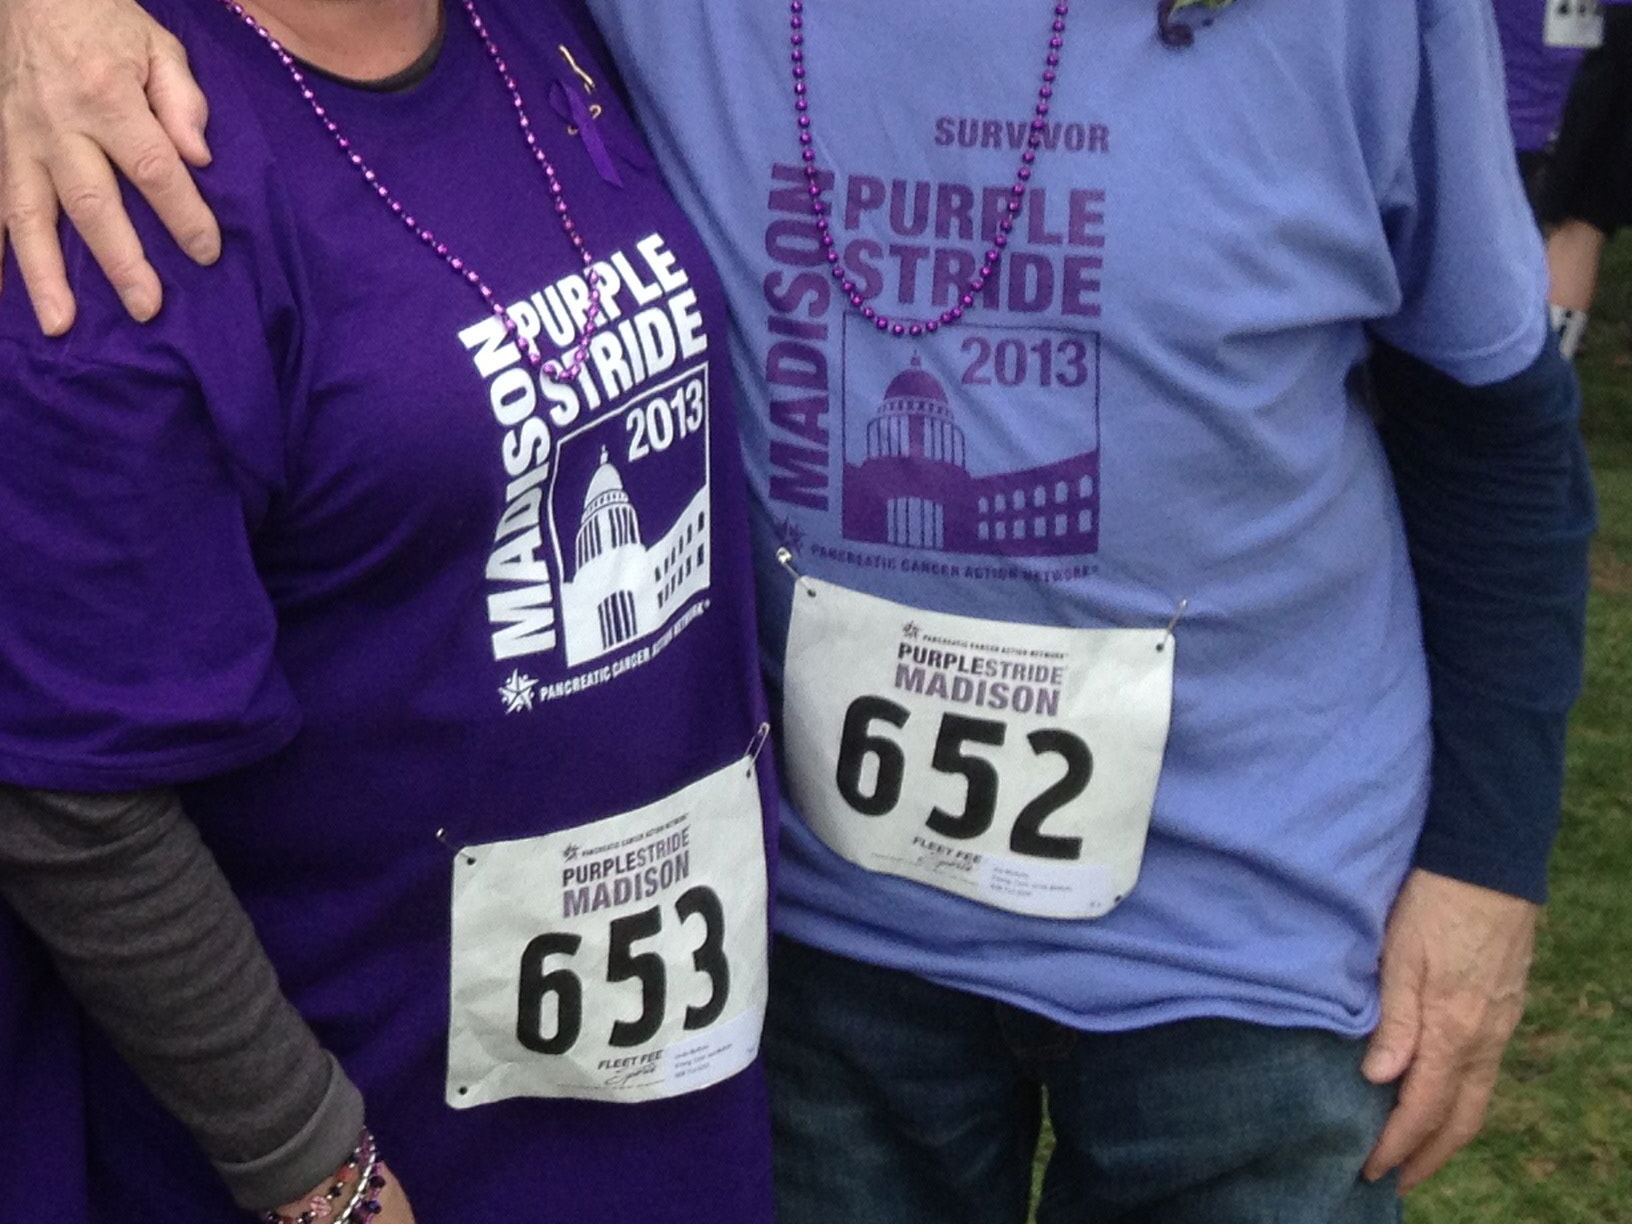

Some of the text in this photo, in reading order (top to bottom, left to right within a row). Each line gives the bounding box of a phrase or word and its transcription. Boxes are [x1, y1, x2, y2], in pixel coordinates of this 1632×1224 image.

[844, 173, 1106, 248] PURPLE
[506, 232, 689, 369] PURPLE
[842, 238, 1103, 317] STRIDE
[539, 287, 709, 426] STRIDE
[763, 162, 836, 512] MADISON
[959, 336, 1089, 389] 2013
[625, 378, 704, 463] 2013
[457, 313, 557, 661] MADISON
[539, 665, 611, 703] PANCREATIC
[893, 662, 1061, 717] MADISON
[897, 641, 1063, 685] PURPLESTRIDE
[836, 694, 1094, 862] 652
[562, 826, 690, 888] PURPLESTRIDE
[562, 849, 689, 918] MADISON
[516, 884, 731, 1056] 653
[597, 1055, 640, 1071] FLEET
